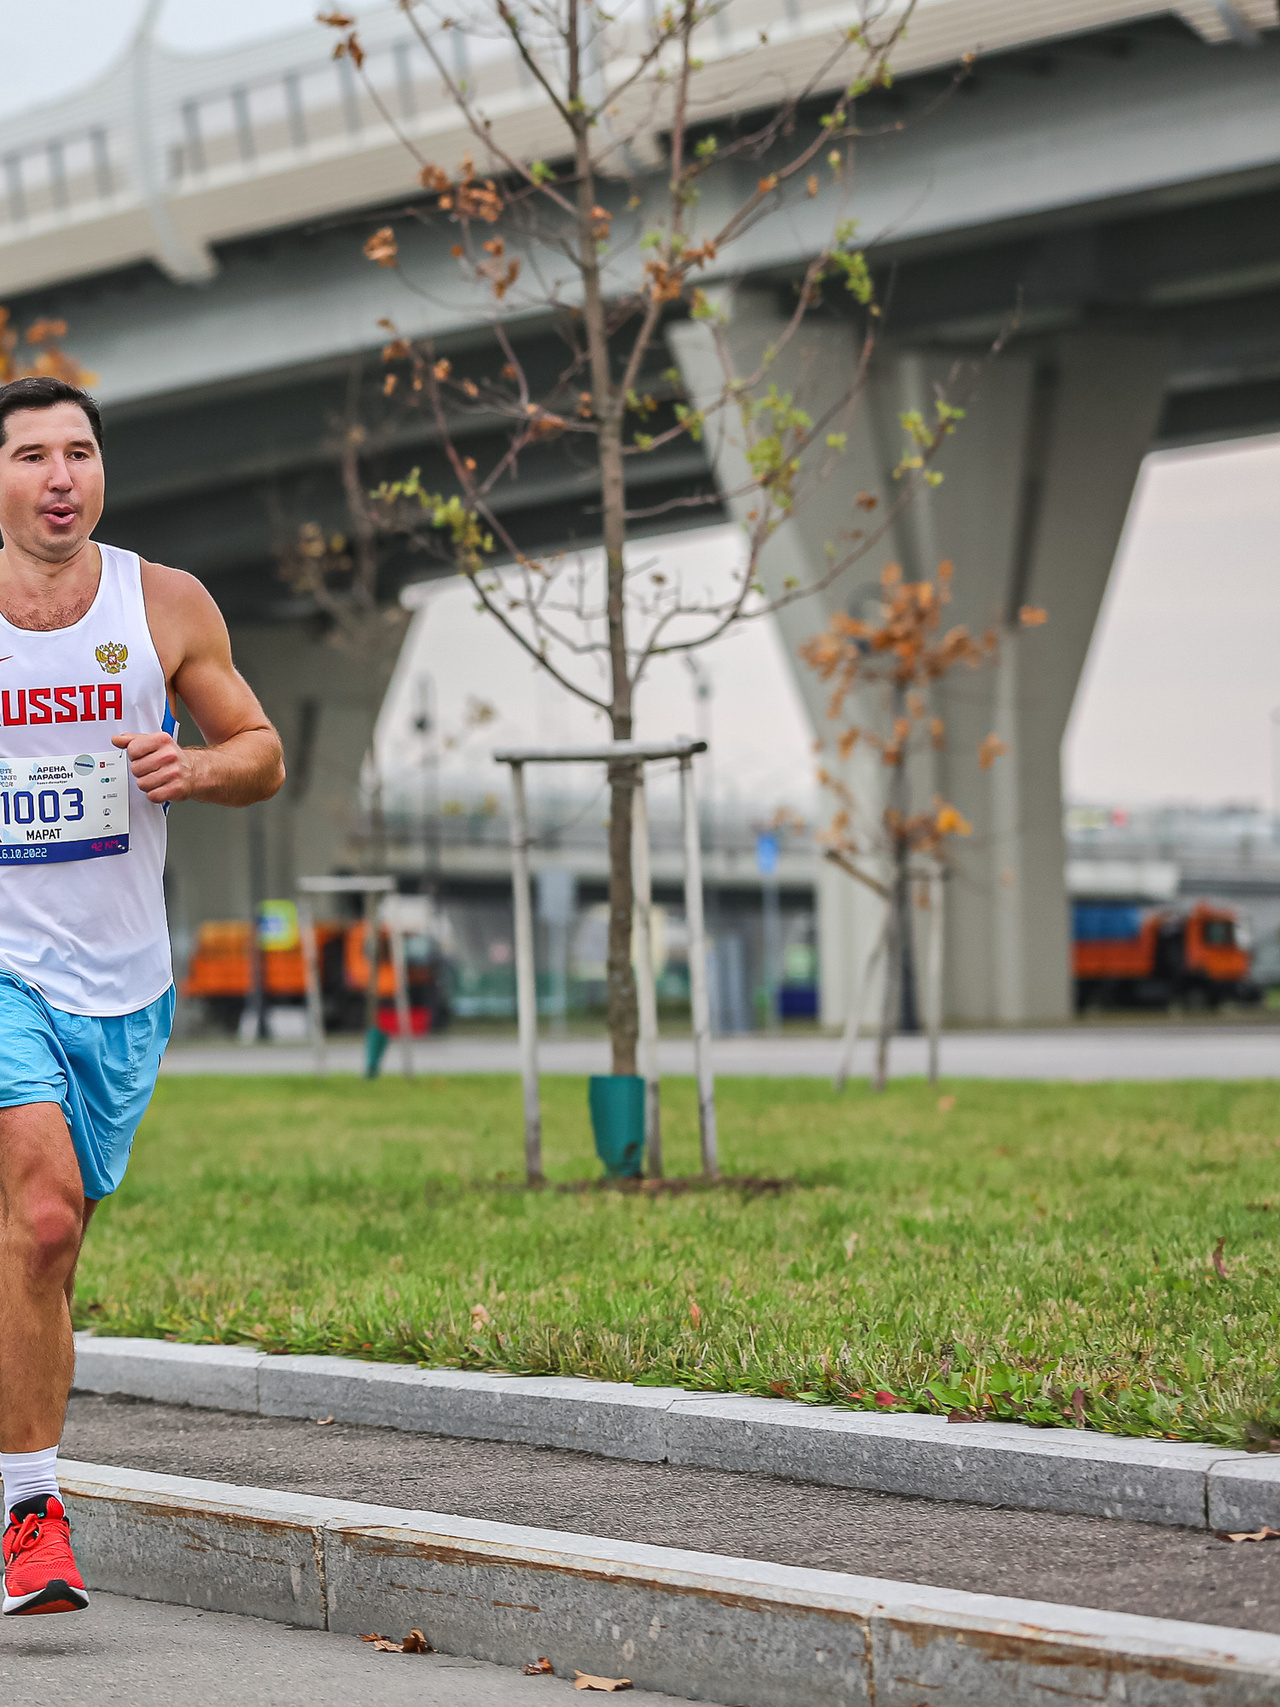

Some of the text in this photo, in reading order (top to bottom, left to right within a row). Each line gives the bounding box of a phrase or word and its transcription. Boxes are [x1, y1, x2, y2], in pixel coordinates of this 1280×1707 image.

[28, 772, 73, 780] МАРАФОН
[0, 788, 84, 824] 1003
[26, 828, 62, 840] МАРАТ
[91, 842, 103, 851] 42
